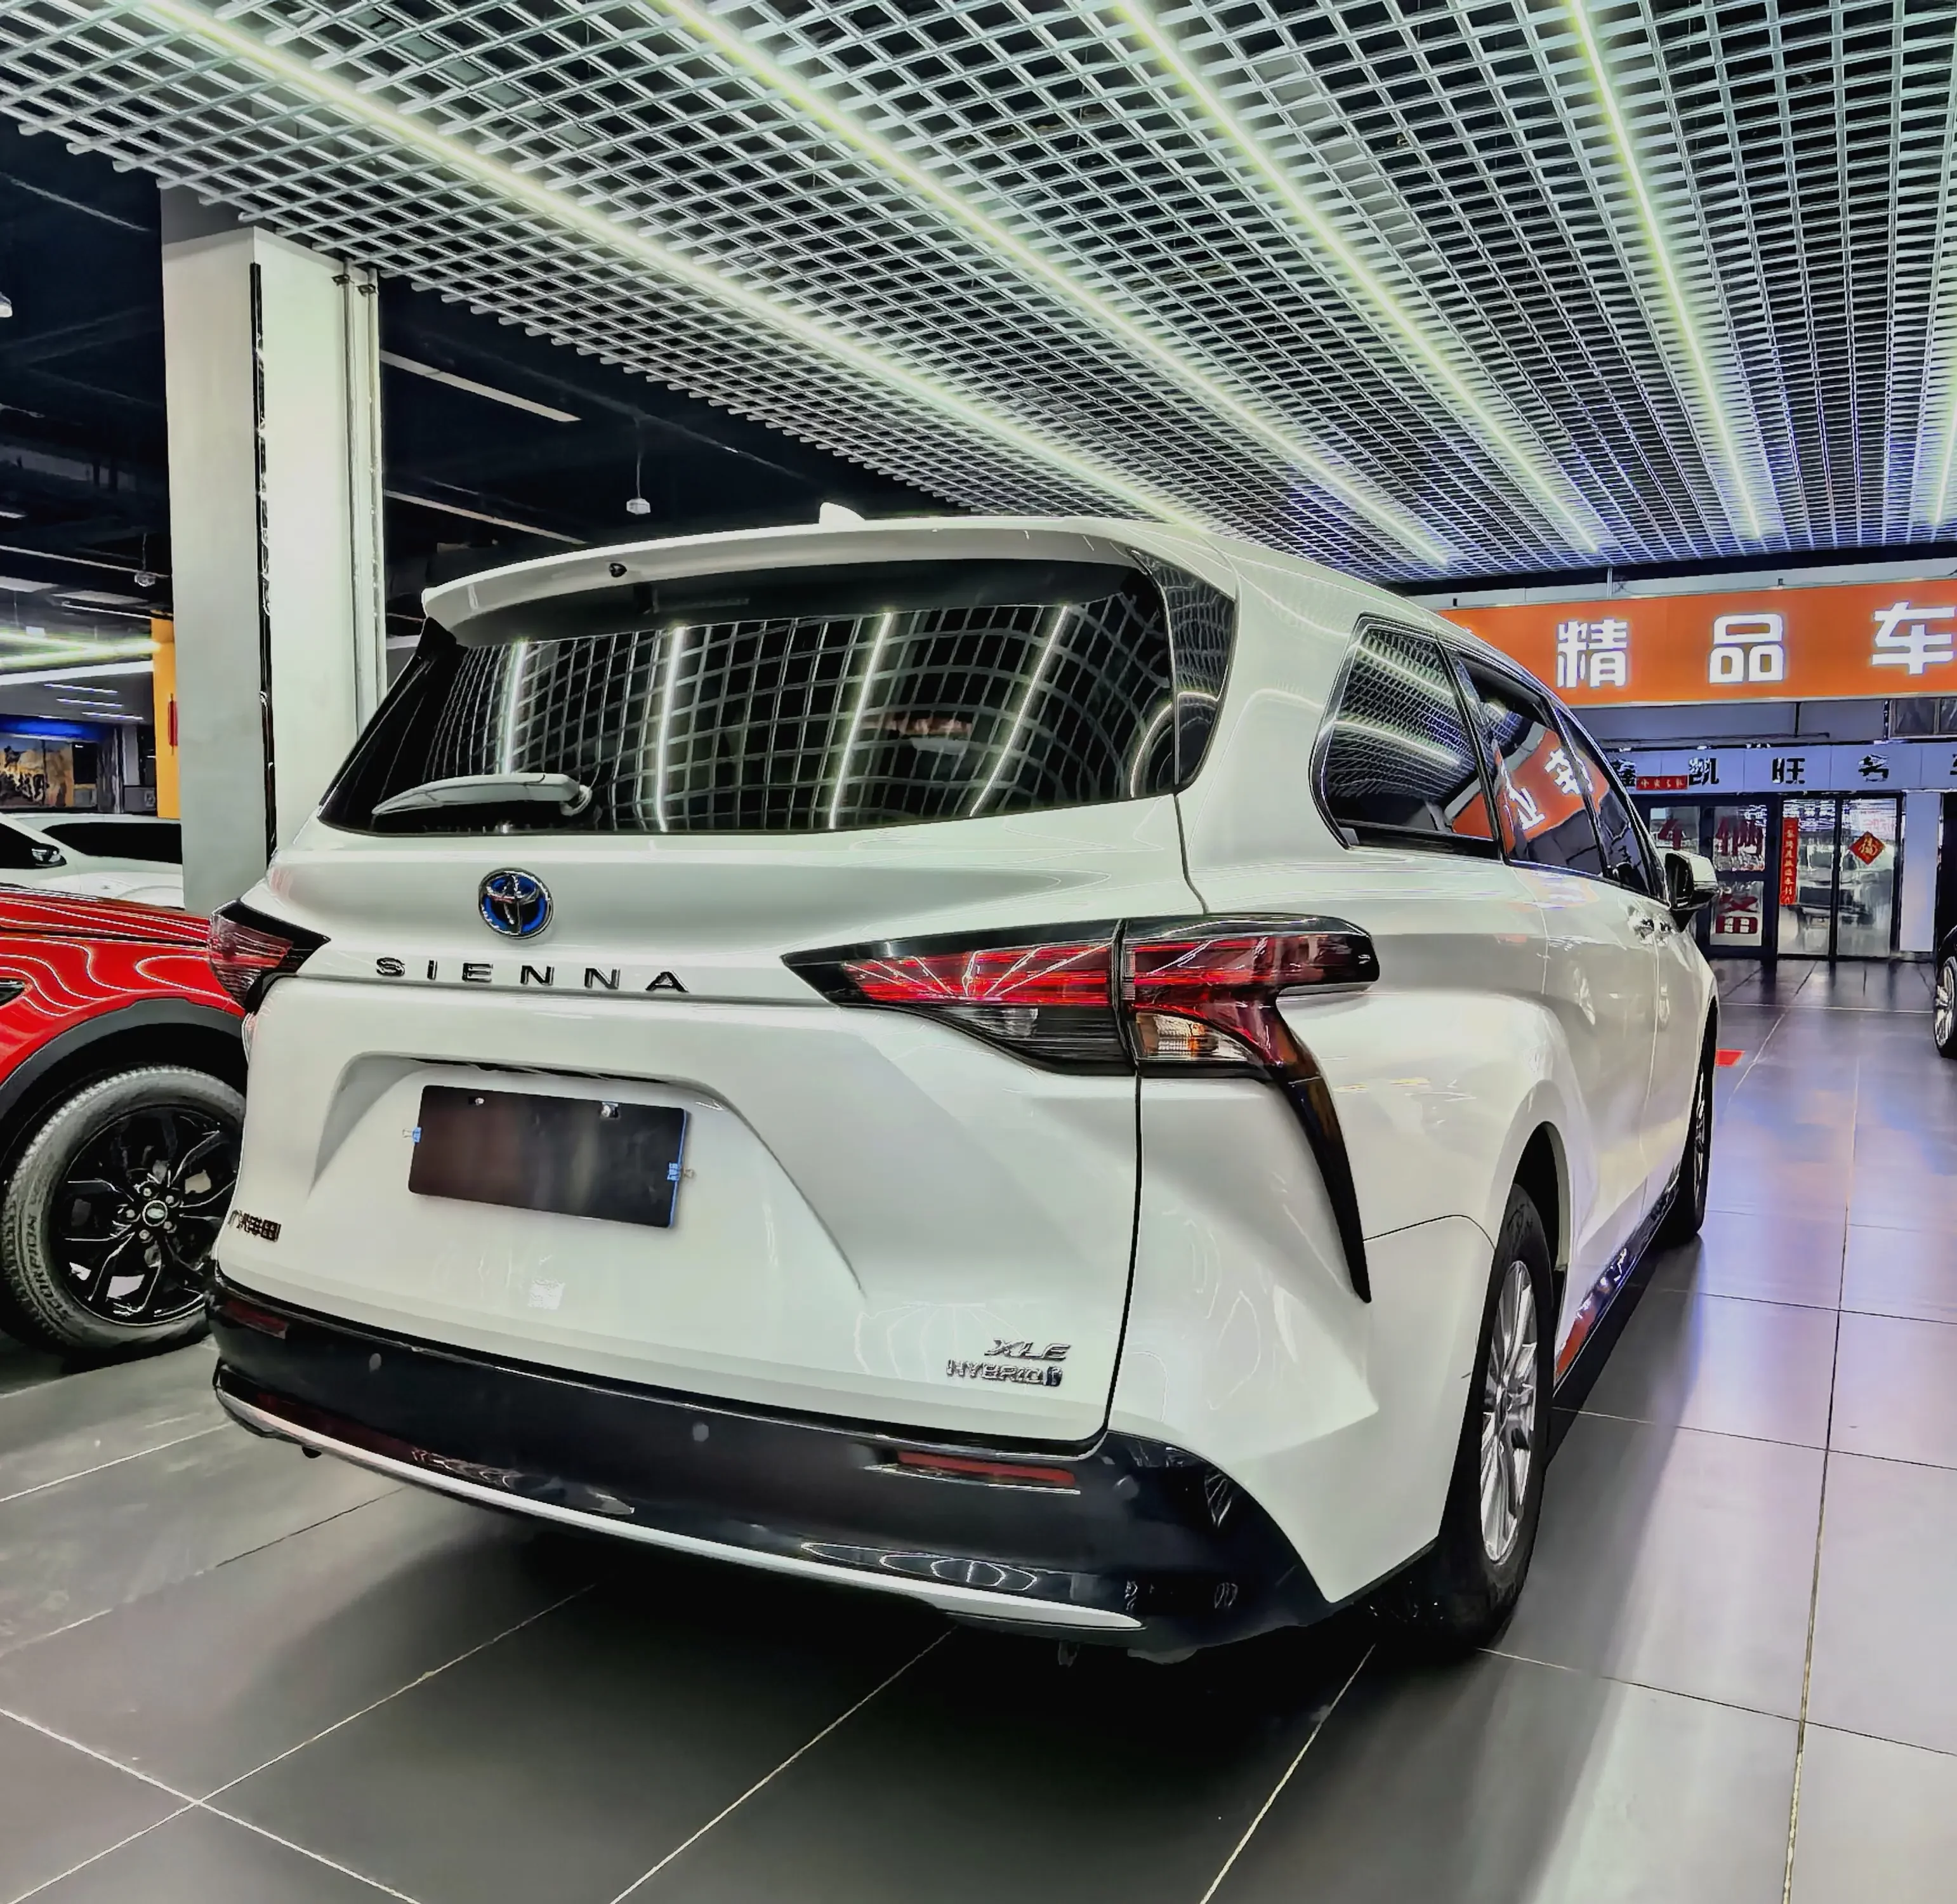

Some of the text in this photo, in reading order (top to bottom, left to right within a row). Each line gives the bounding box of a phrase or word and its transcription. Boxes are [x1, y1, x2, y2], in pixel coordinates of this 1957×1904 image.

[1556, 601, 1956, 689] 精品车
[376, 956, 689, 993] SIENNA
[984, 1337, 1072, 1361] XLE
[946, 1359, 1044, 1385] HYBRID
